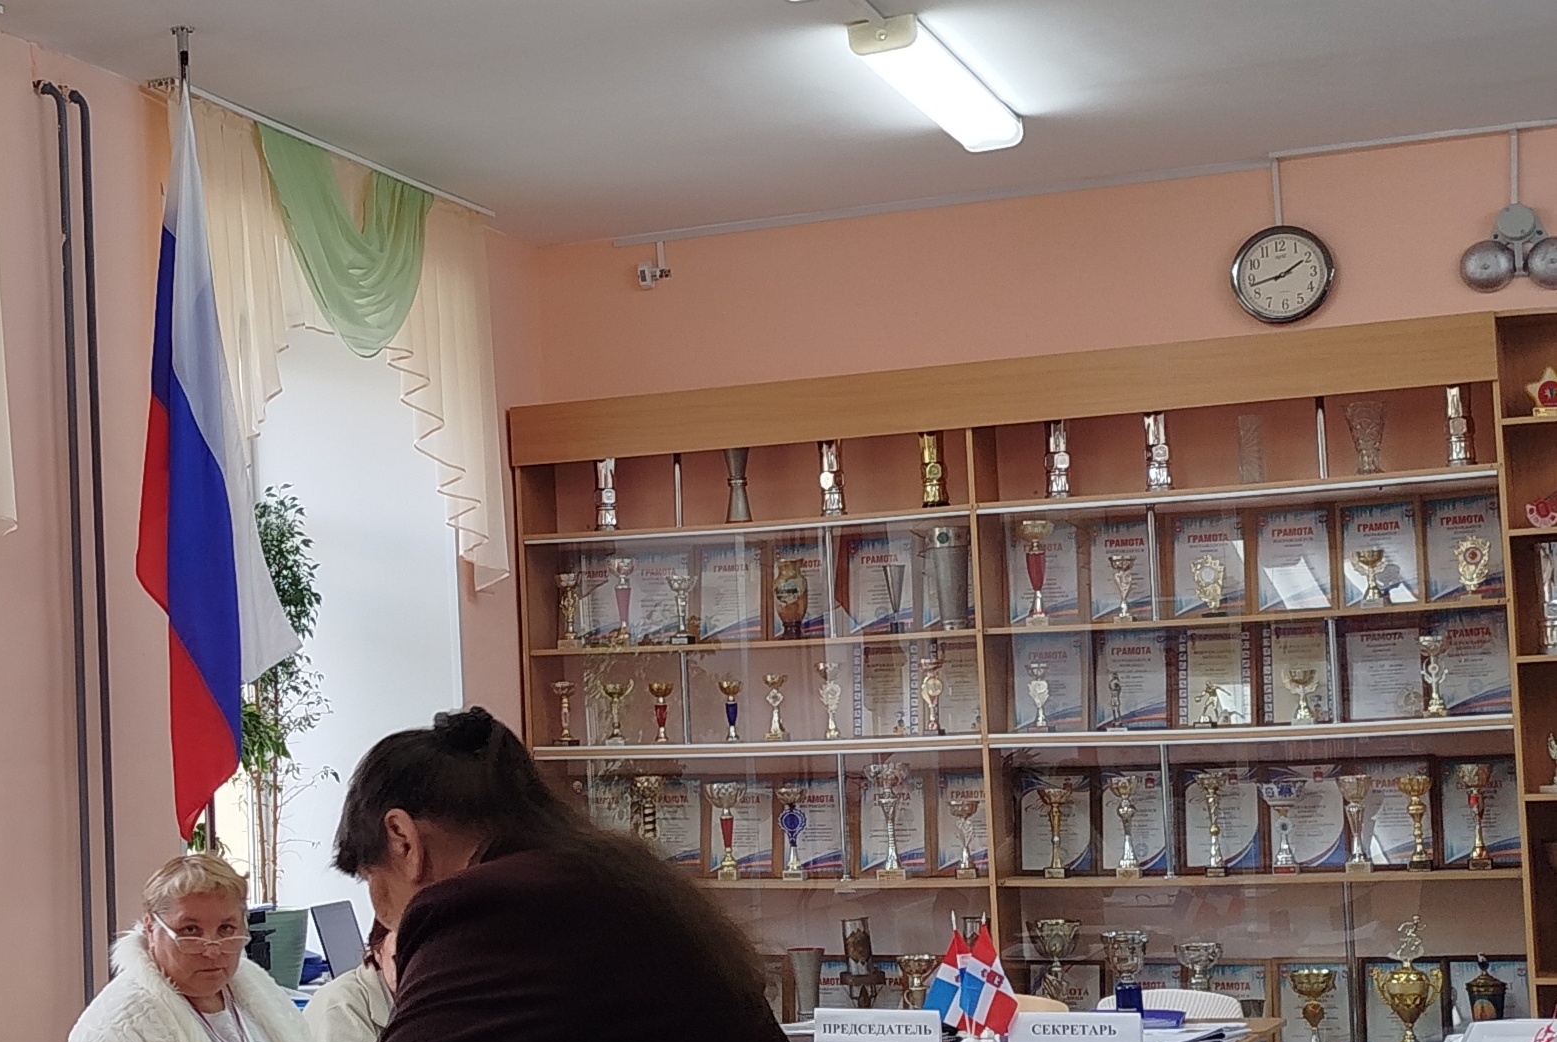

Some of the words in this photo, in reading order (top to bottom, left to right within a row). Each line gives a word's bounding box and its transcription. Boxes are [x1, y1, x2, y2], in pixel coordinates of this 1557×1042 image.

[1260, 246, 1269, 258] 11
[1274, 240, 1286, 252] 12
[1293, 241, 1298, 254] 1
[1304, 251, 1312, 263] 2
[1249, 258, 1260, 270] 10
[1309, 265, 1318, 277] 3
[1248, 273, 1256, 287] 9
[1306, 281, 1315, 292] 4
[1253, 287, 1261, 299] 8
[1296, 292, 1304, 304] 5
[1265, 296, 1273, 308] 7
[1281, 298, 1289, 310] 6
[1357, 520, 1400, 533] ГРАМОТА
[1440, 514, 1485, 527] ГРАМОТА
[1187, 532, 1228, 544] ГРАМОТА
[1271, 526, 1314, 538] ГРАМОТА
[1104, 537, 1145, 548] ГРАМОТА
[860, 553, 899, 565] ГРАМОТА
[1360, 631, 1404, 643] ГРАМОТА
[1446, 626, 1492, 640] ГРАМОТА
[1110, 646, 1152, 656] ГРАМОТА
[822, 1022, 933, 1037] ПРЕДСЕДАТЕЛЬ
[1031, 1022, 1118, 1037] СЕКРЕТАРЬ
